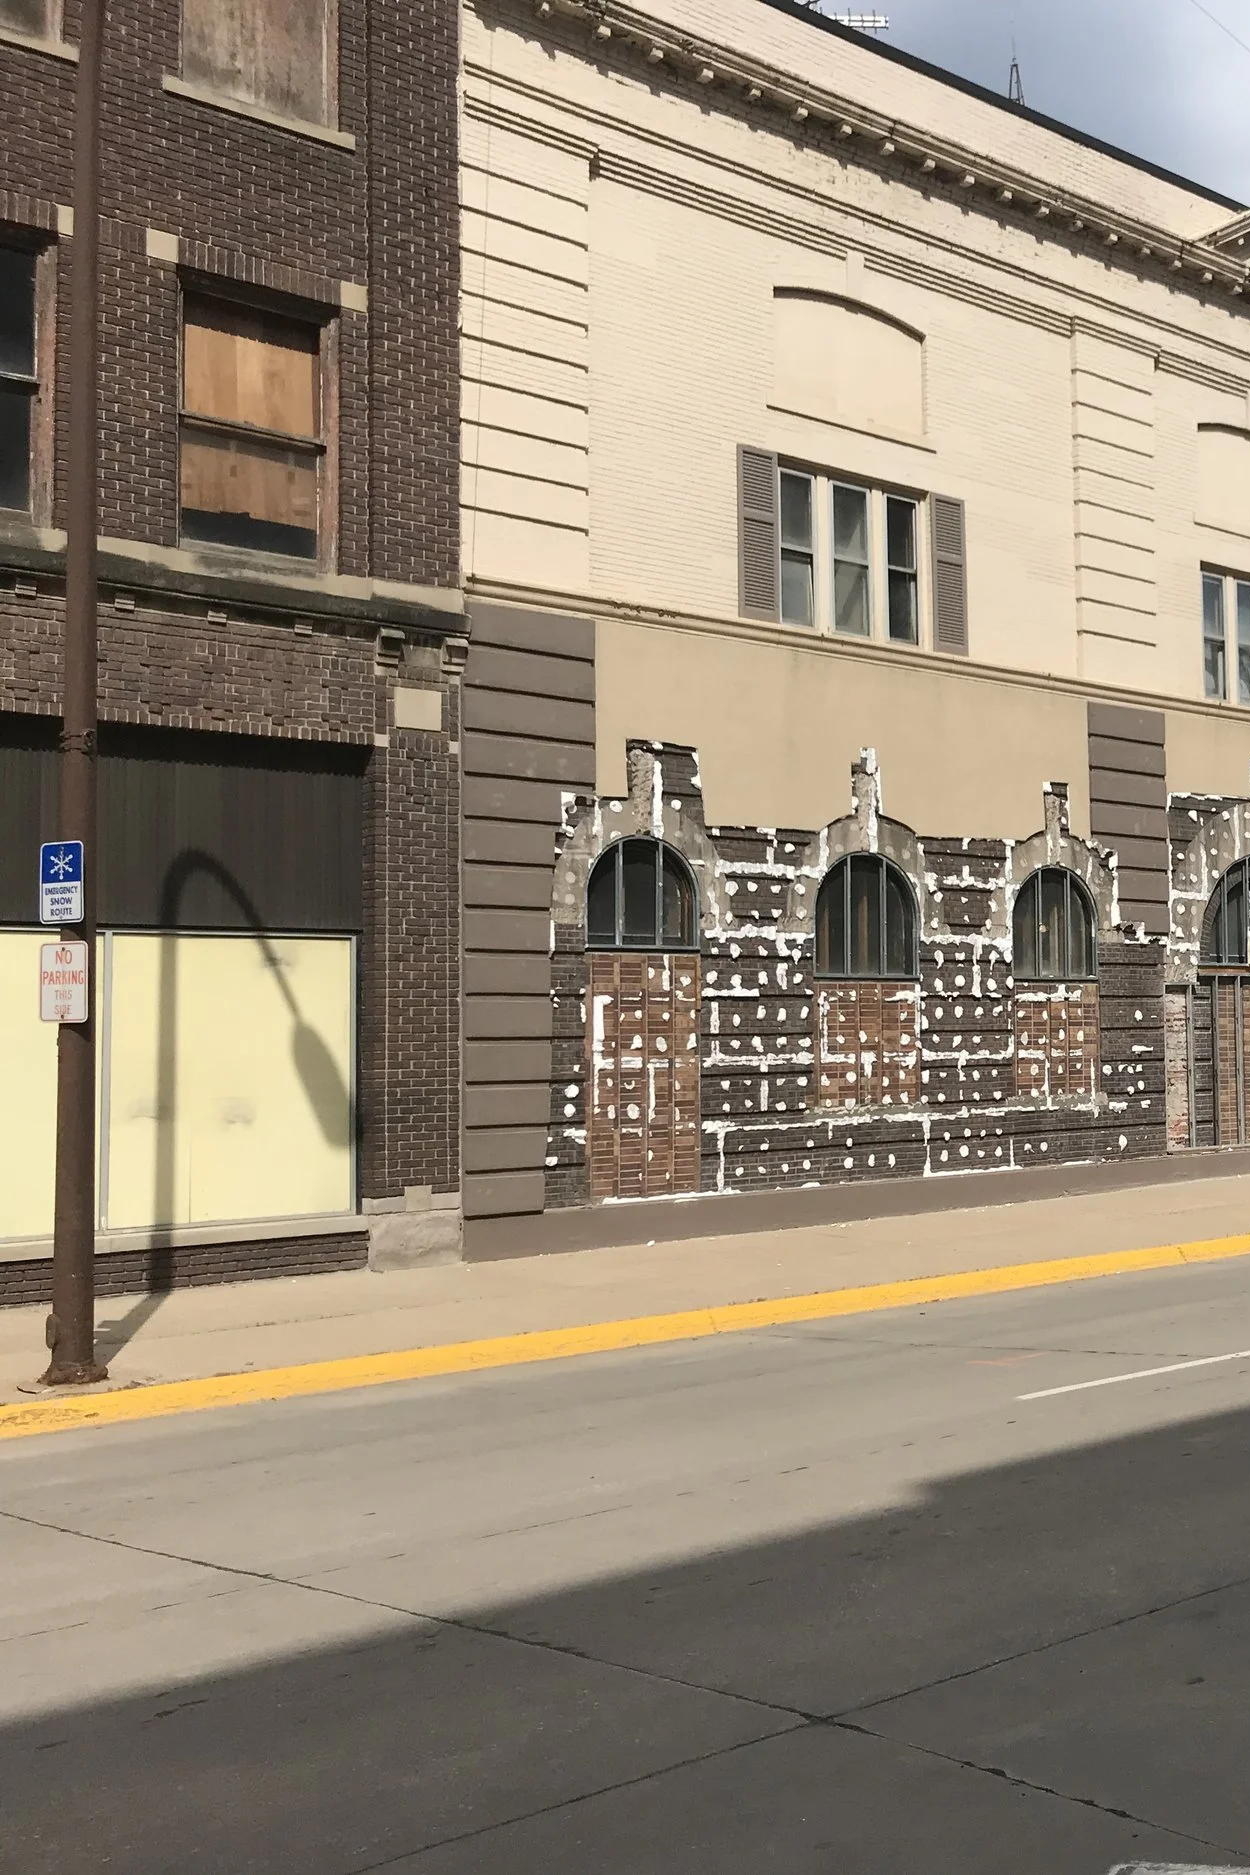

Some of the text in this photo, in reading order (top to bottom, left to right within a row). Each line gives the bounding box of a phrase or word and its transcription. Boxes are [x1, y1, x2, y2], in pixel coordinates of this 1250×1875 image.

[45, 886, 78, 895] EMERGENCY
[50, 897, 72, 906] SNOW
[50, 907, 73, 917] ROUTE
[55, 950, 73, 965] NO
[42, 971, 85, 985] PARKING
[54, 989, 73, 1001] THIS
[54, 1004, 72, 1015] SIDE
